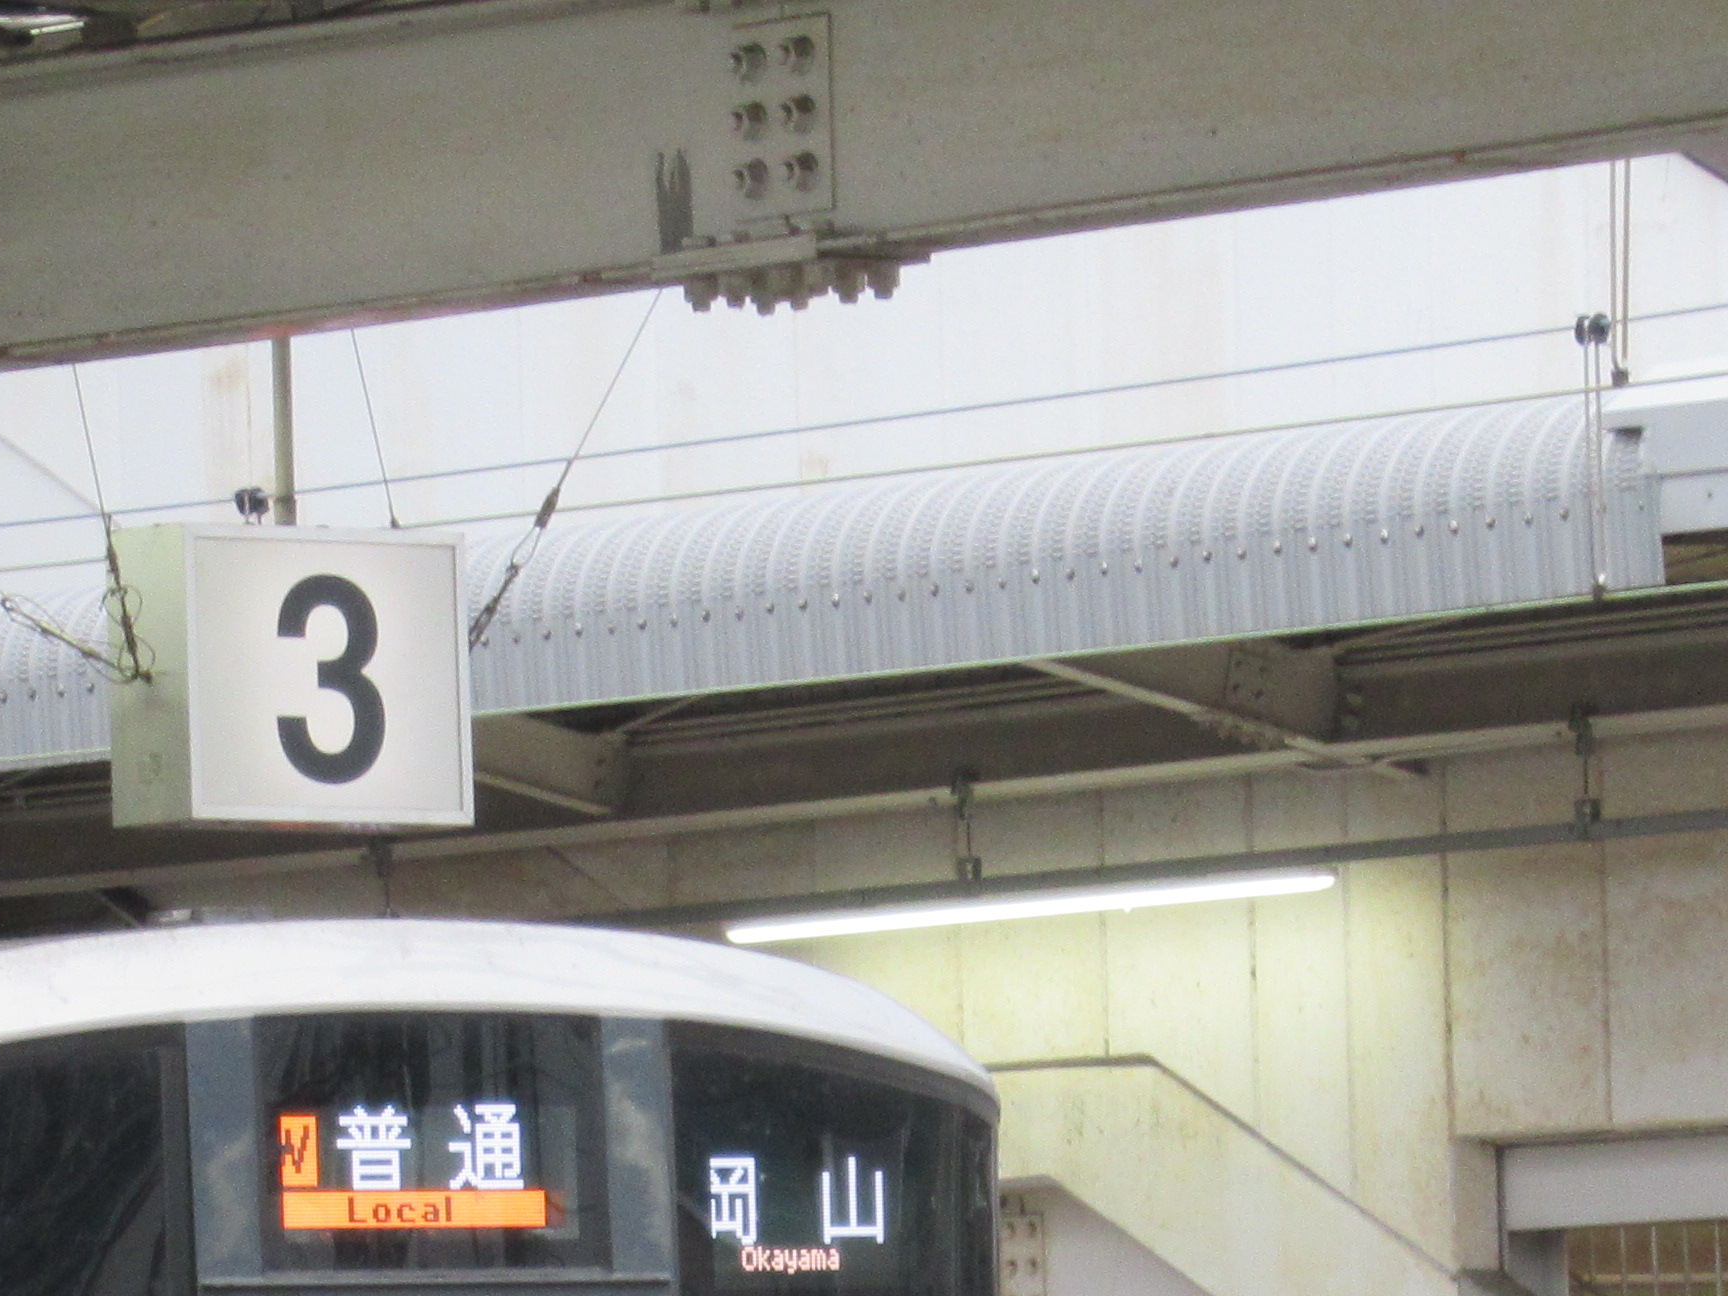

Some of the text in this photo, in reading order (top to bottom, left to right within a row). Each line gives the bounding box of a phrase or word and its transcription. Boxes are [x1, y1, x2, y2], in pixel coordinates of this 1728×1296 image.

[276, 572, 386, 784] 3
[336, 1103, 525, 1191] 普通
[347, 1195, 453, 1223] Local
[709, 1156, 885, 1246] 岡山
[741, 1246, 841, 1275] Okayama
